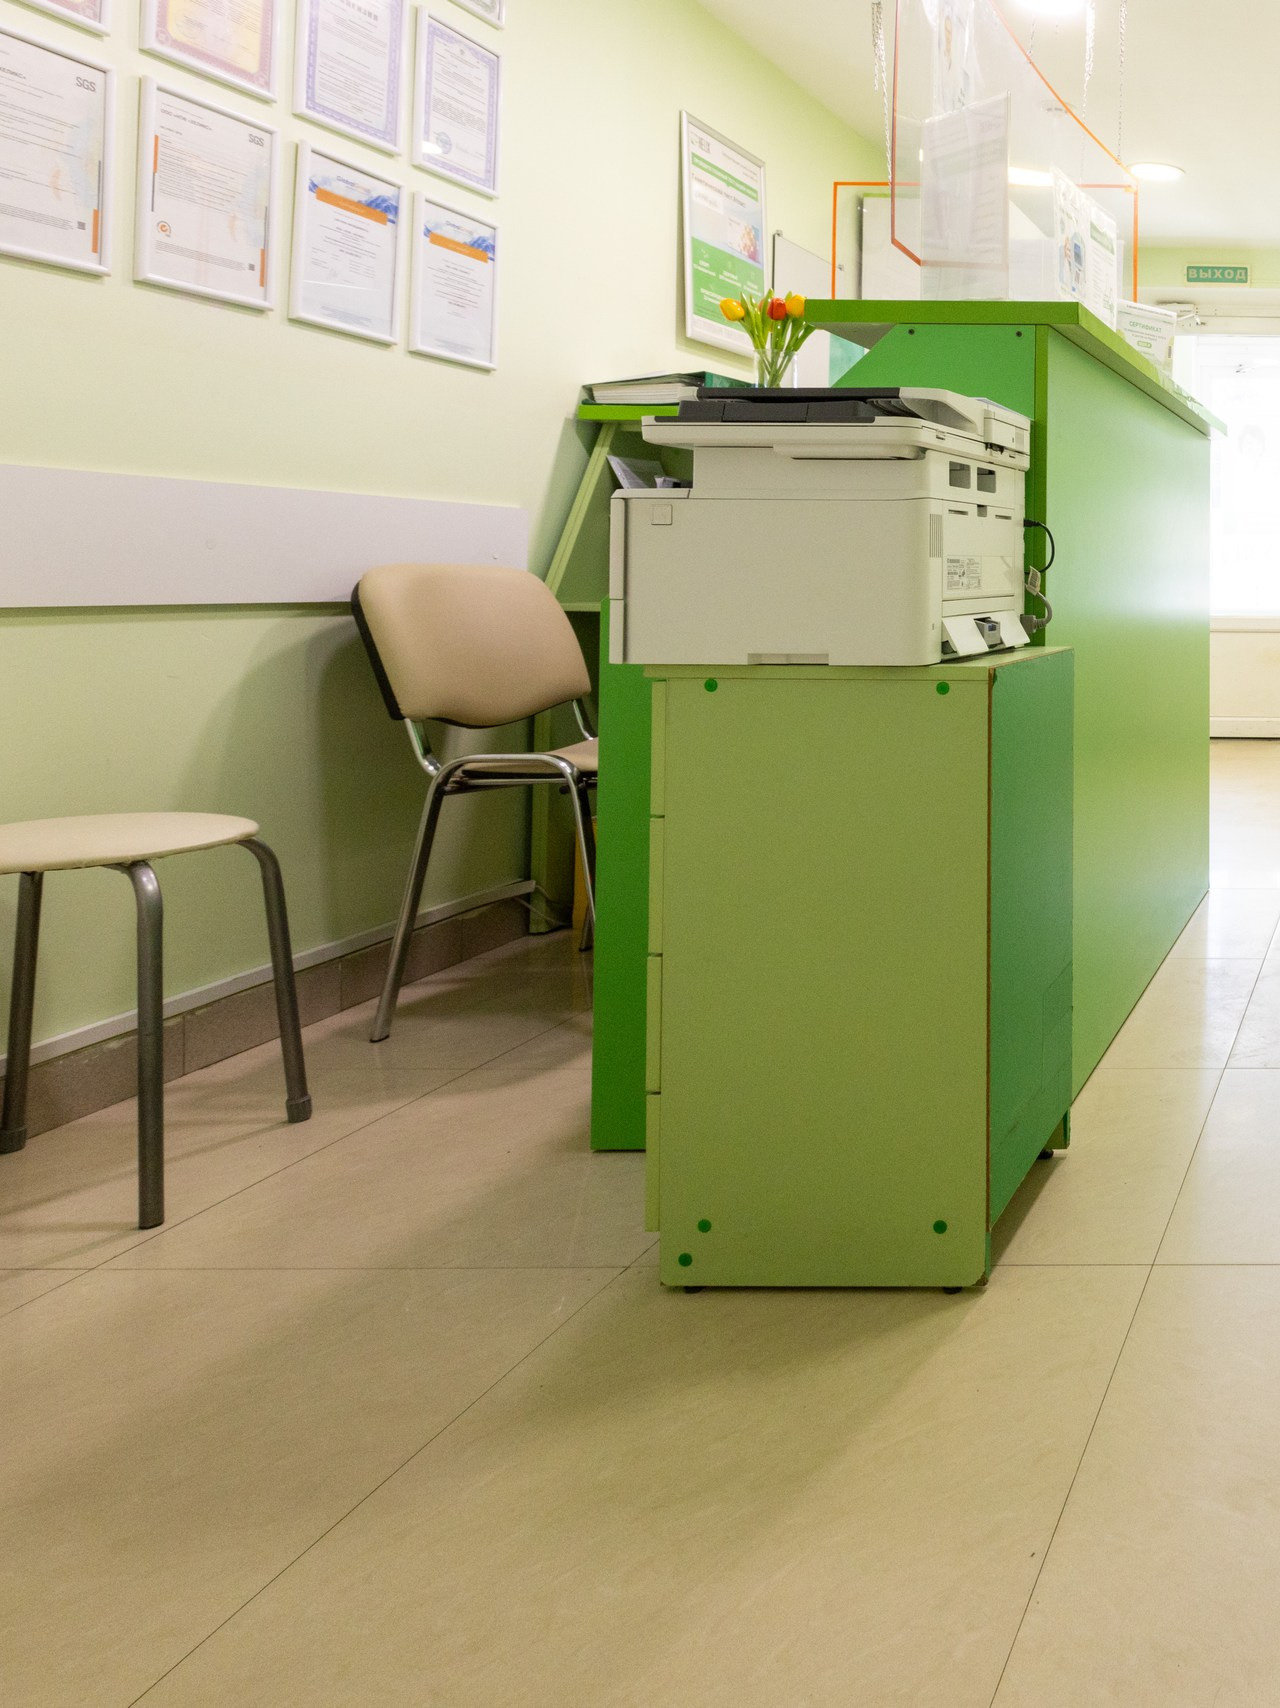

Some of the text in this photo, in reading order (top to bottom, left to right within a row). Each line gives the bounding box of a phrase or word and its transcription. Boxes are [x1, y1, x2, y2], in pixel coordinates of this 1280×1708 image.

[75, 76, 97, 93] SGS
[248, 132, 264, 148] SGS
[1188, 268, 1246, 281] ВЫХОД
